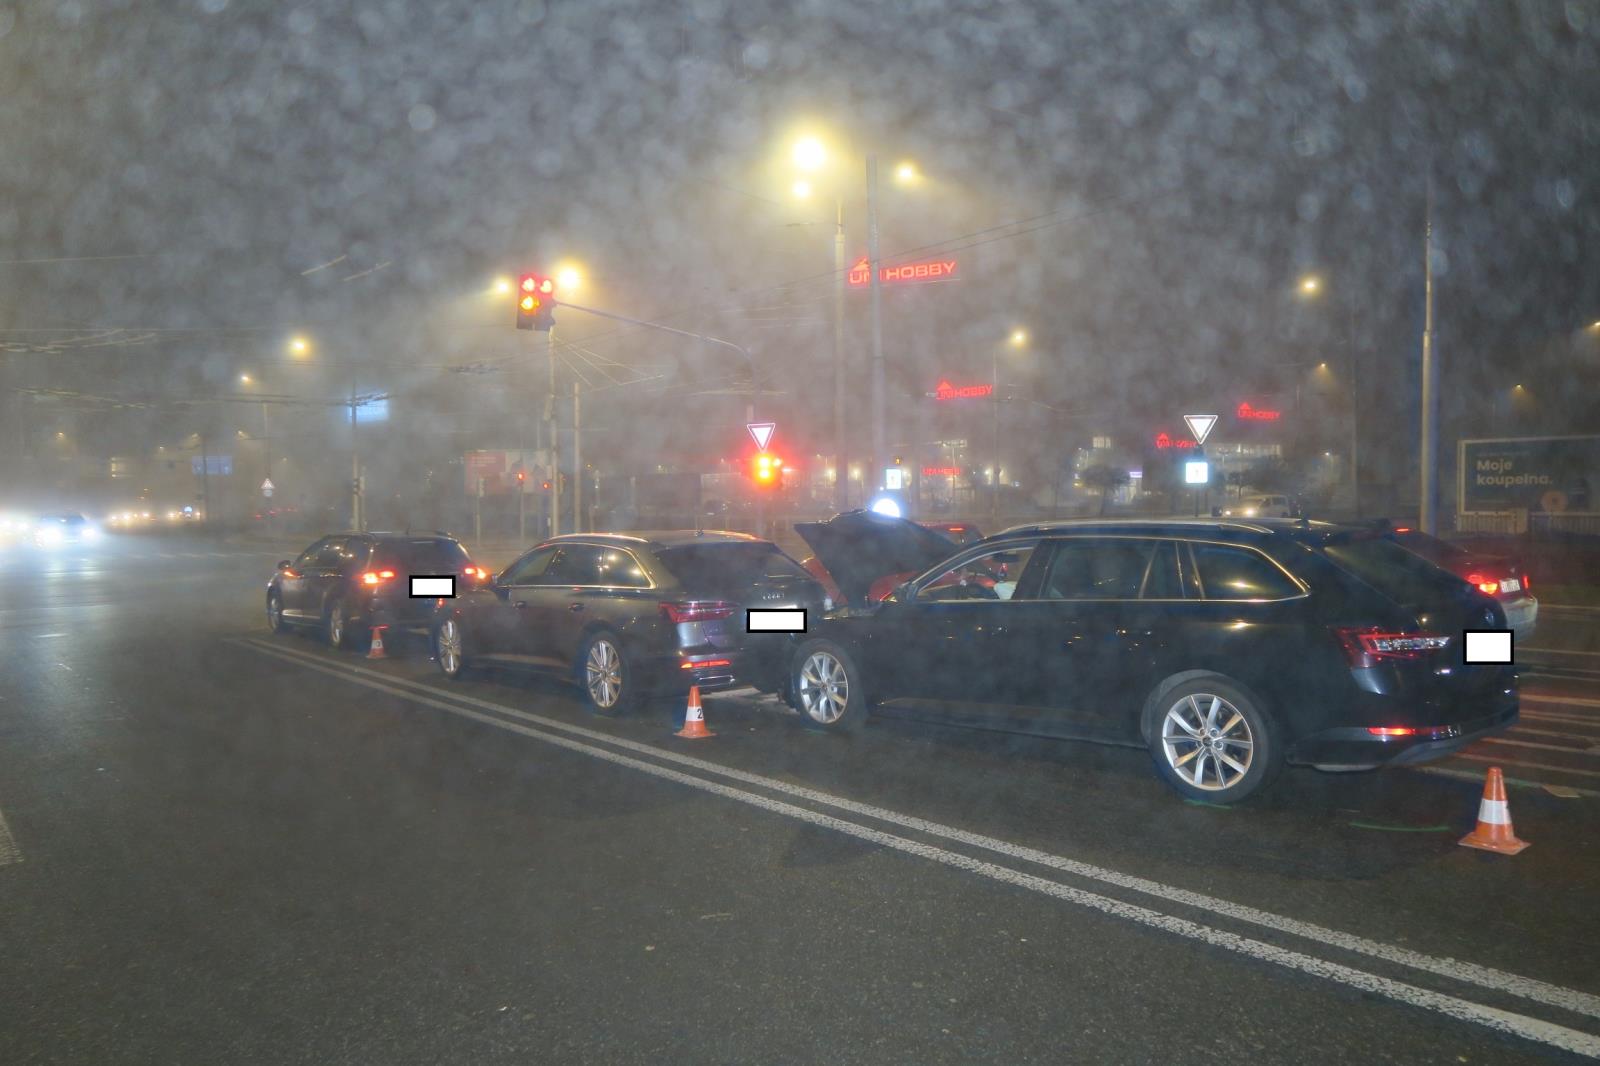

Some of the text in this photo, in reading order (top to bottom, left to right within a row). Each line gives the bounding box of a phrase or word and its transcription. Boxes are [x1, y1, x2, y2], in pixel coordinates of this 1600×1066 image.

[1477, 459, 1512, 473] Moje
[1477, 473, 1553, 488] koupelna.
[697, 708, 703, 719] 2
